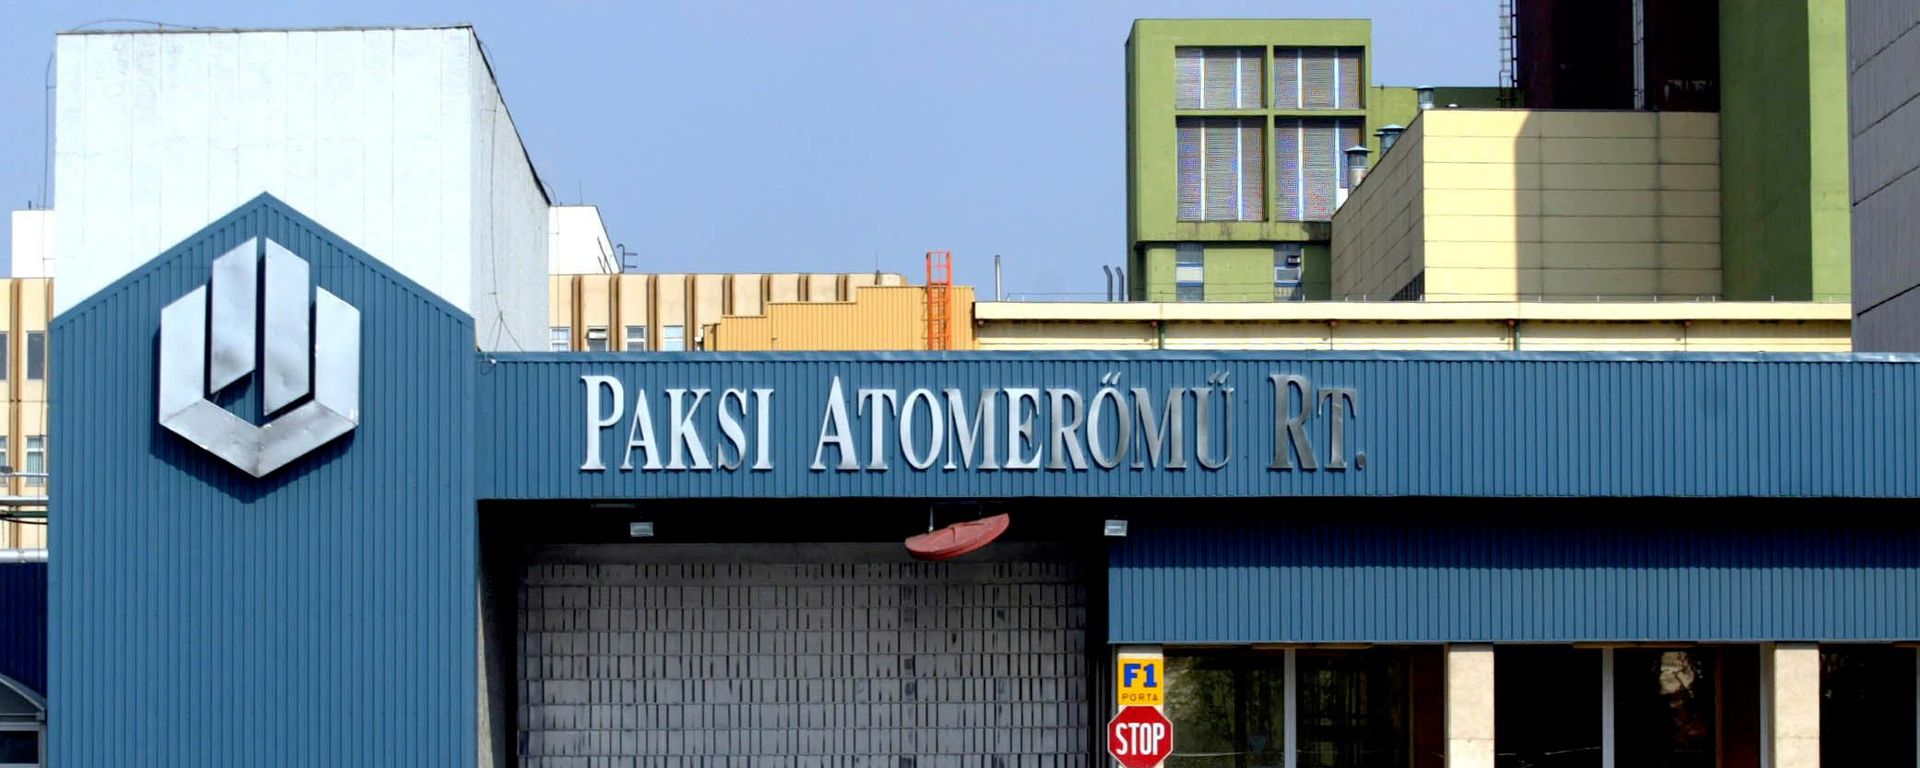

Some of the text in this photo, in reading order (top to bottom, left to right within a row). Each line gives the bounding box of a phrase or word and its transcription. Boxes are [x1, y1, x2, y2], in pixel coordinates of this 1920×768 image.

[580, 375, 774, 471] PAKSI
[811, 371, 1235, 471] ATOMERŐMŰ
[1123, 663, 1158, 687] F1
[1122, 693, 1159, 702] PORTA
[1115, 722, 1165, 756] STOP
